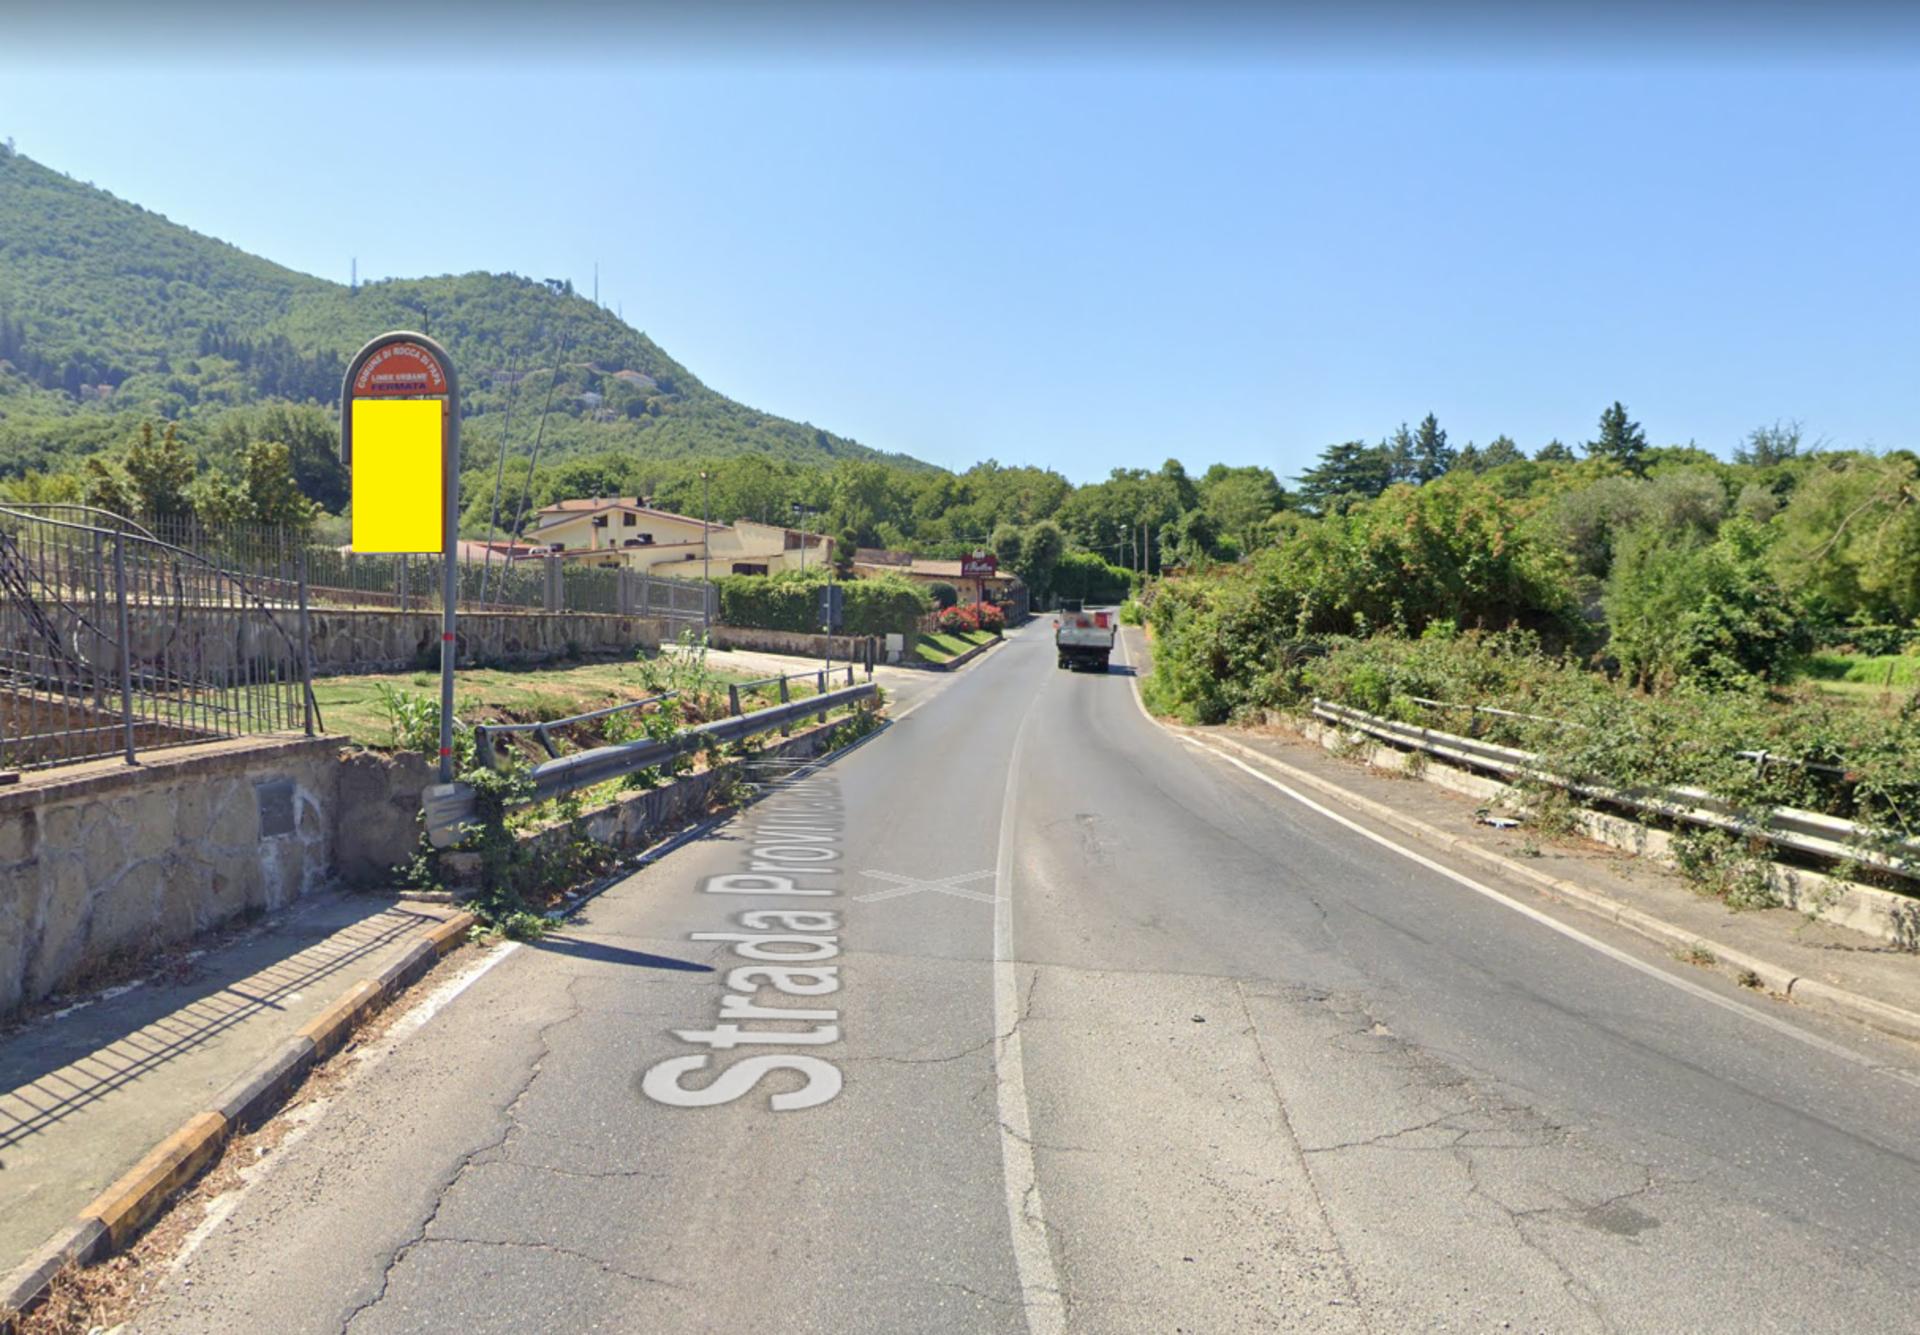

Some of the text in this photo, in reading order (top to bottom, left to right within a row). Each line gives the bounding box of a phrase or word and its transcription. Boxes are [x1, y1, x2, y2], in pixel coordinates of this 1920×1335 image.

[358, 348, 441, 388] COMUNE DI ROCCA DI PAPA
